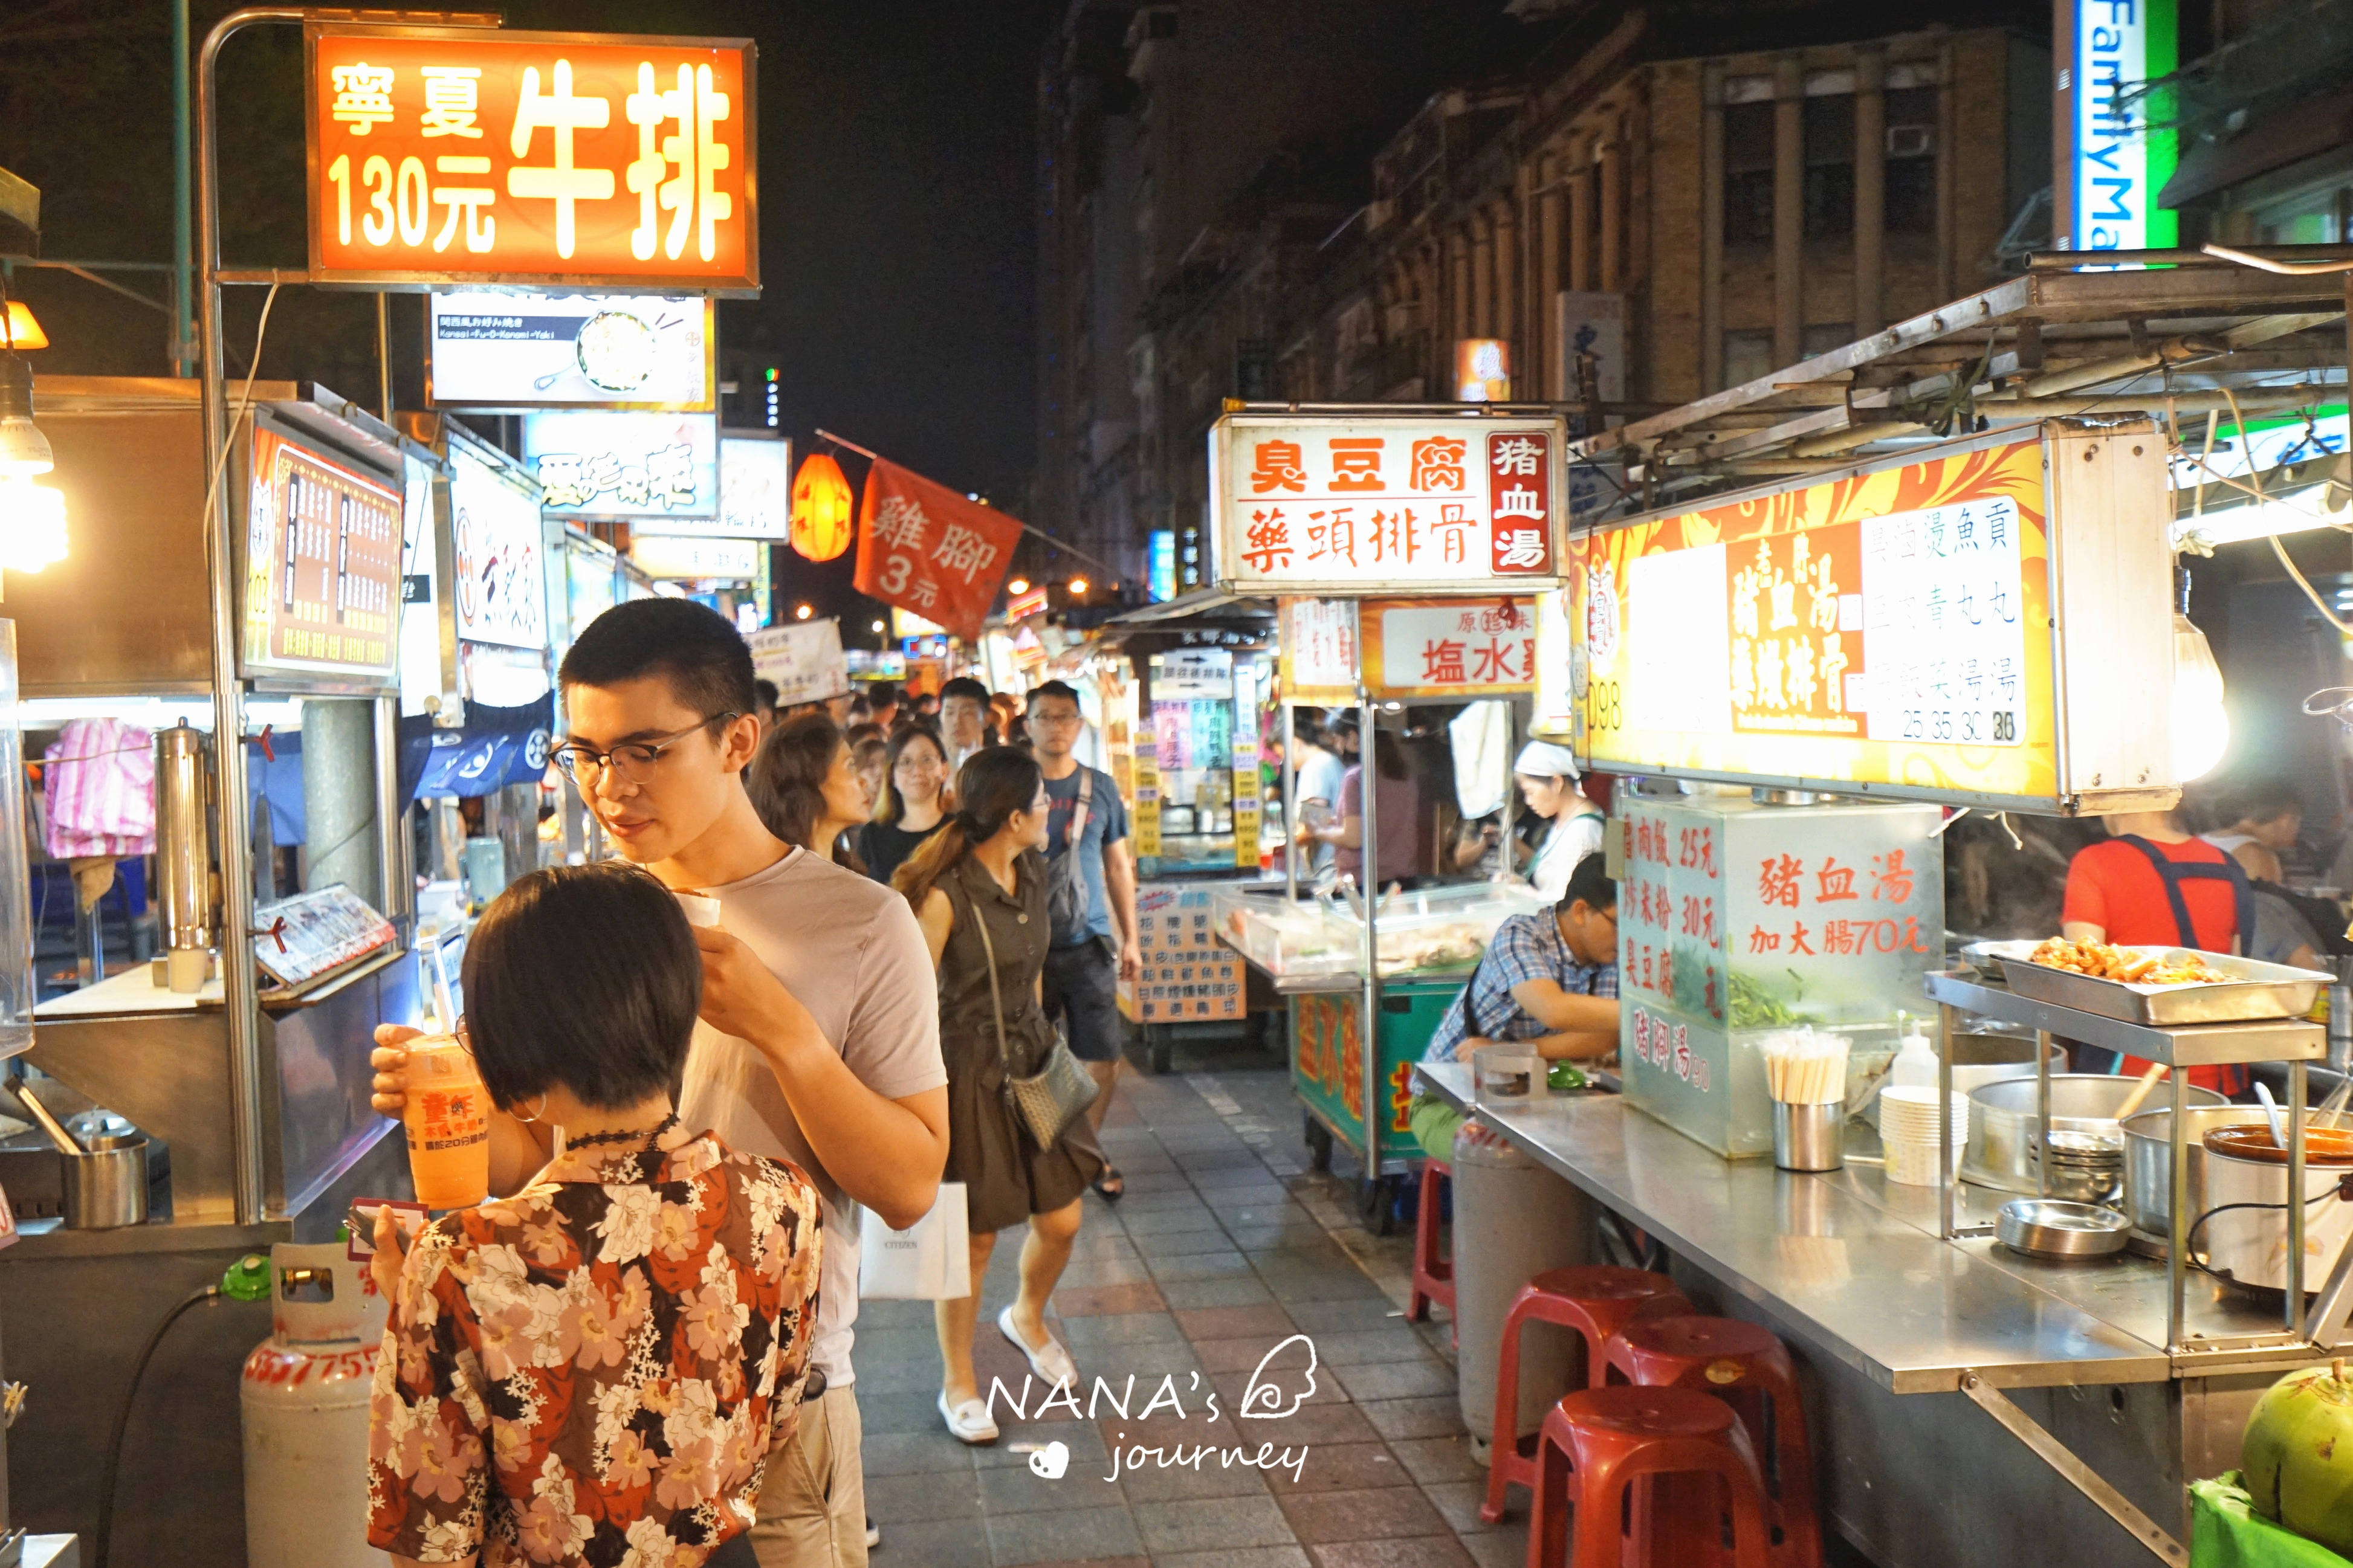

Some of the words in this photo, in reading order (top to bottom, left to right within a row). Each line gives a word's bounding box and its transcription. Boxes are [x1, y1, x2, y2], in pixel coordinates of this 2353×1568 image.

[331, 62, 484, 138] 寧夏
[507, 59, 732, 262] 牛排
[2086, 0, 2134, 271] FamilyMa
[329, 153, 496, 254] 130元
[1251, 436, 1468, 493] 臭豆腐
[1492, 438, 1547, 569] 猪血湯
[869, 494, 998, 586] 雞腳
[1241, 503, 1478, 575] 藥頭排骨
[879, 553, 939, 608] 3元
[1924, 512, 1952, 700] 燙青菜
[1954, 508, 1983, 701] 魚丸湯
[1986, 503, 2017, 702] 貢丸湯
[1422, 637, 1535, 683] 塩水
[1903, 710, 1923, 738] 25
[1931, 711, 1952, 740] 35
[1993, 712, 2015, 741] 30
[1680, 827, 1718, 879] 25元
[1758, 849, 1915, 908] 豬血湯
[1682, 894, 1720, 949] 30元
[1625, 937, 1674, 999] 臭豆腐
[884, 1241, 918, 1250] CITIZEN
